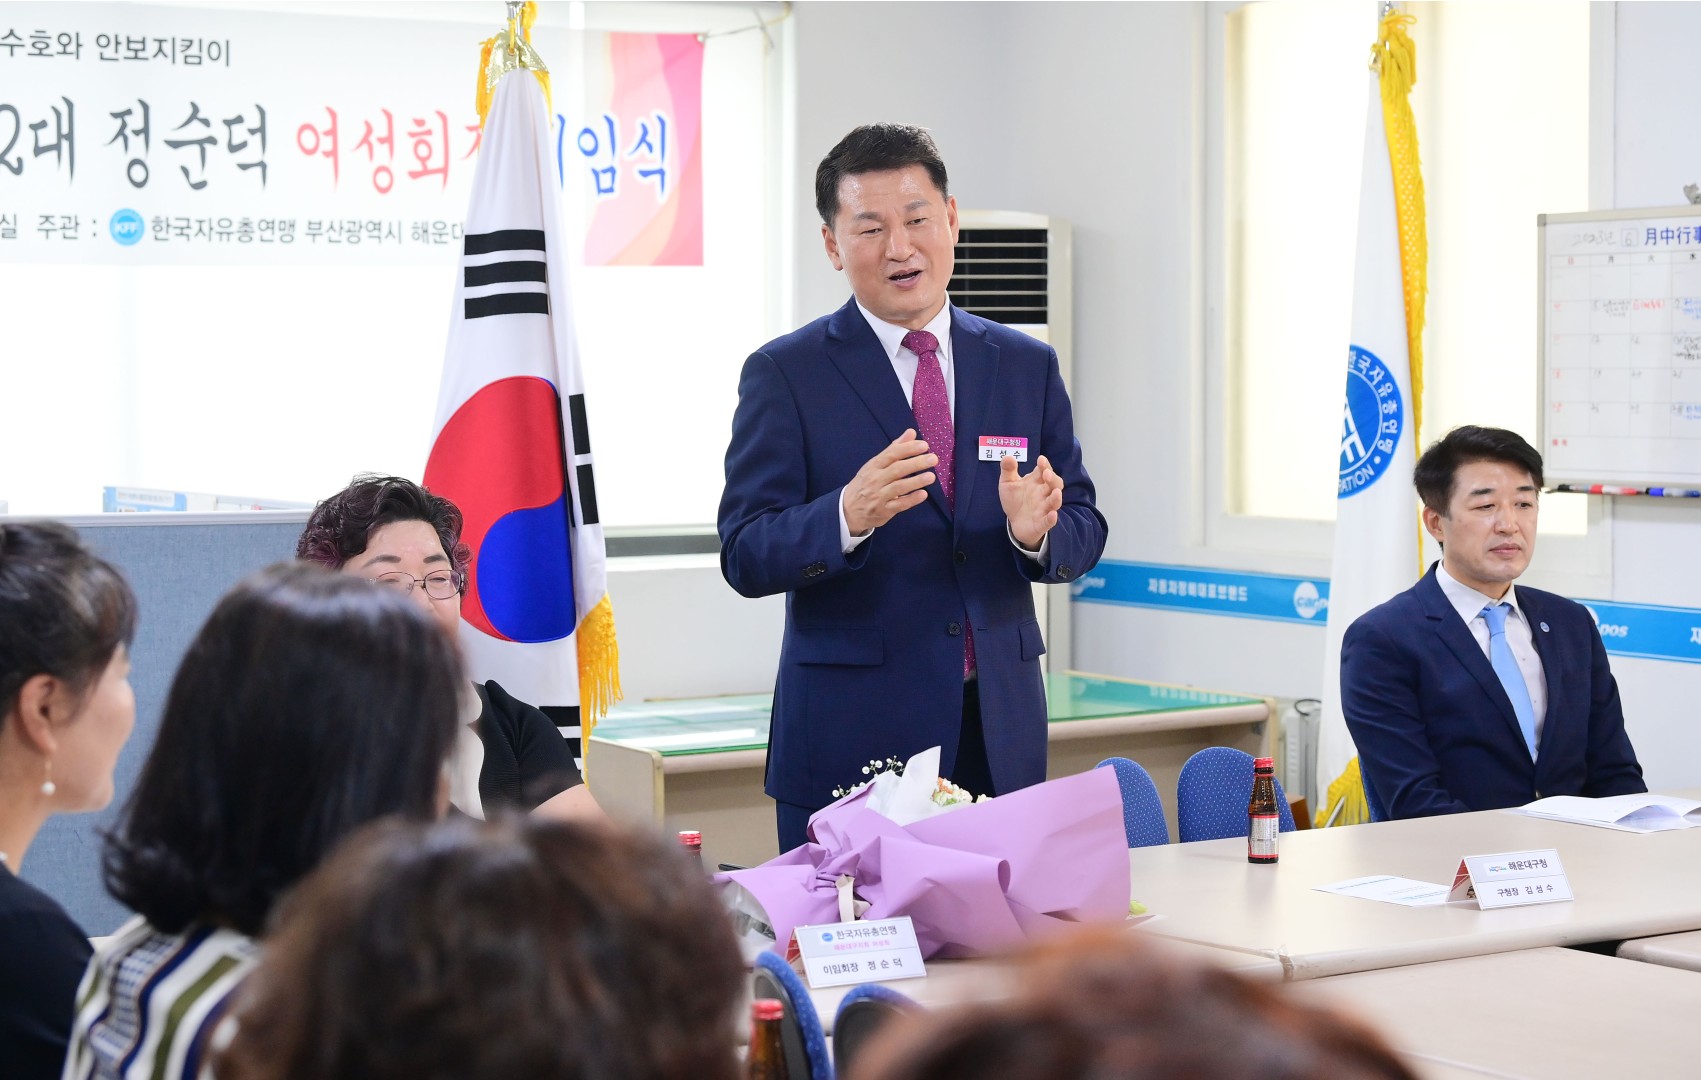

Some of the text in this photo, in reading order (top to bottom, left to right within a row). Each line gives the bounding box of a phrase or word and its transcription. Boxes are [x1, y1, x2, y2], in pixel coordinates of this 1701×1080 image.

[0, 28, 230, 67] 수호와 안보지킴이
[104, 98, 268, 190] 정순덕
[37, 214, 80, 240] 주관
[151, 214, 296, 243] 한국자유총연맹
[305, 218, 402, 245] 부산광역시
[1508, 858, 1548, 871] 해운대구청
[1497, 887, 1519, 898] 구청장
[836, 925, 898, 940] 한국자유총연맹
[823, 962, 859, 975] 이임회장
